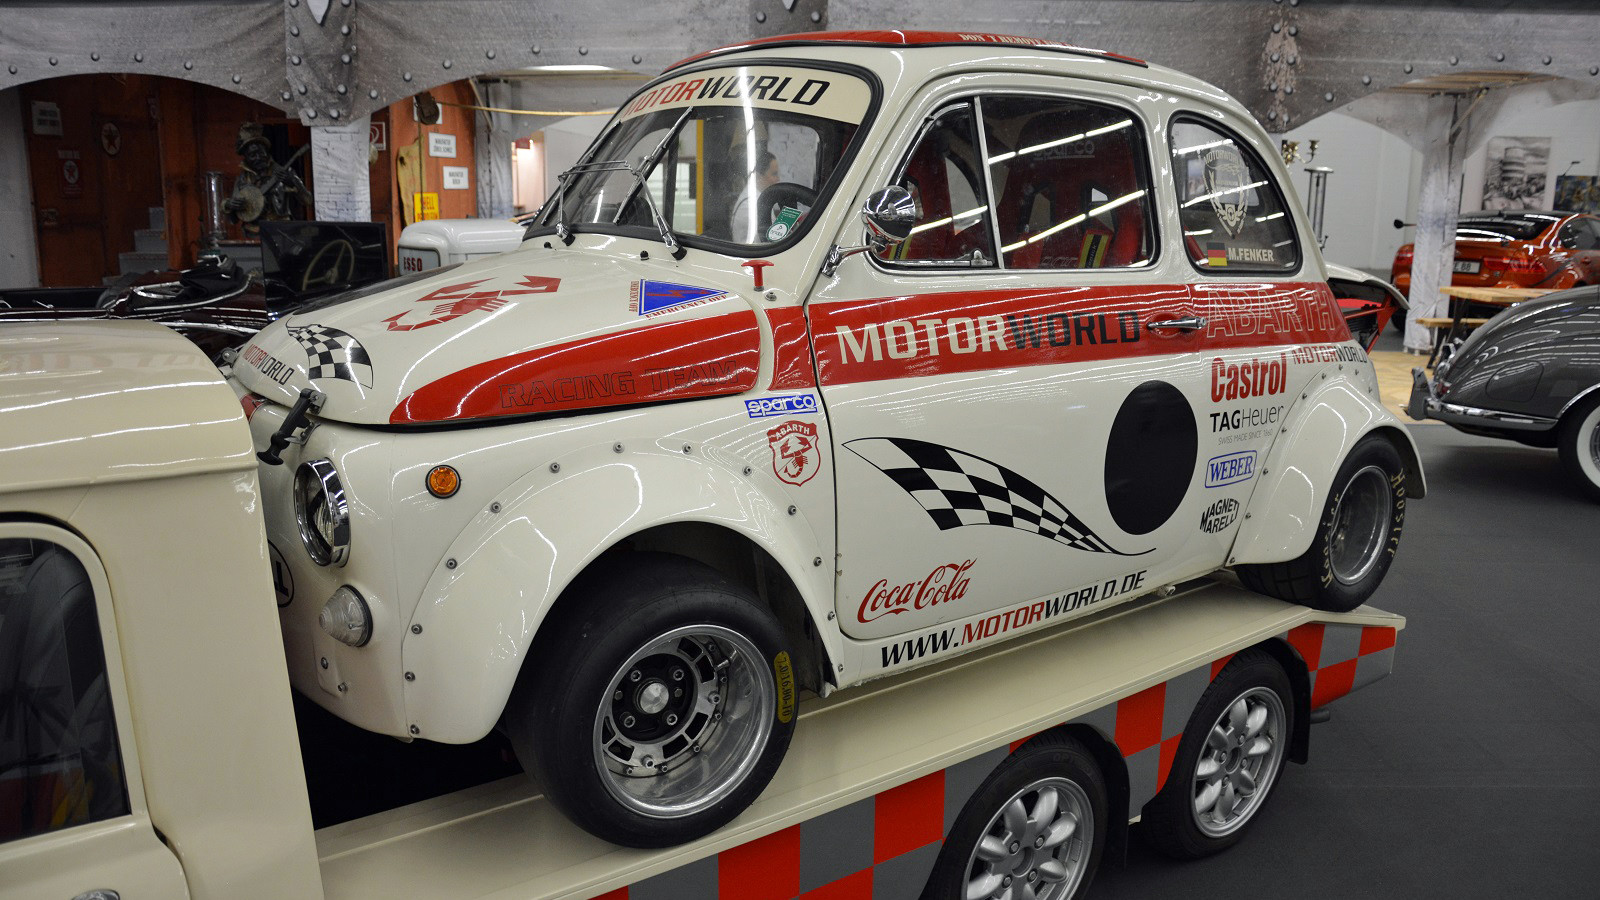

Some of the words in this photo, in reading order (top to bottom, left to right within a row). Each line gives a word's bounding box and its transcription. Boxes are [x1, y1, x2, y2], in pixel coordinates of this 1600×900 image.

[622, 75, 830, 118] MOTORWORLD
[403, 256, 423, 272] ESSO
[1228, 247, 1274, 262] M.FENKER
[645, 299, 707, 320] EMERGENCY
[1207, 289, 1336, 338] ABARTH
[835, 309, 1141, 365] MOTORWORLD
[1292, 346, 1368, 365] MOTORWORLD
[499, 371, 636, 409] RACING
[645, 360, 739, 392] TEAM
[1211, 352, 1287, 403] Castrol
[748, 395, 815, 417] sparco
[776, 423, 810, 440] ABARTH
[1210, 455, 1253, 483] WEBER
[881, 569, 1148, 668] WWW.MOTORWORLD.DE
